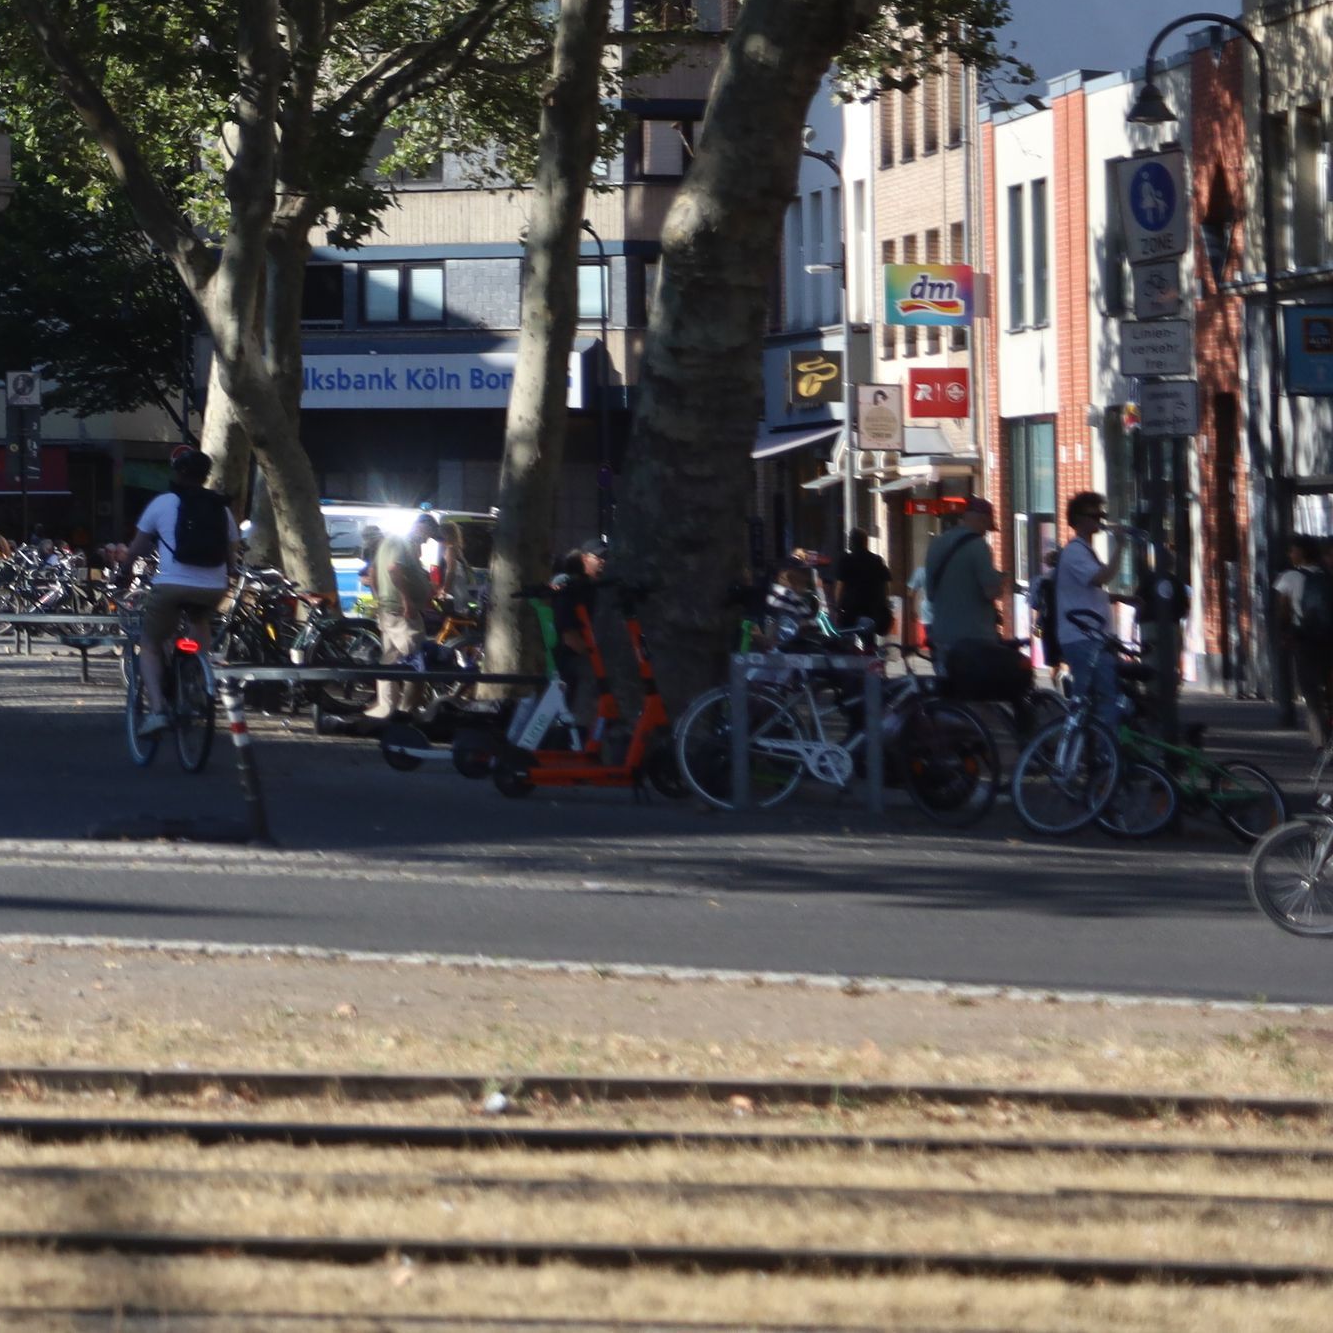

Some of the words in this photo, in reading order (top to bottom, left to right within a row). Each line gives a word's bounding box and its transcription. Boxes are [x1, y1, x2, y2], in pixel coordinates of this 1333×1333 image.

[1140, 232, 1175, 255] ZONE
[909, 273, 956, 299] dm
[302, 366, 397, 391] lksbank
[406, 366, 460, 391] Köln
